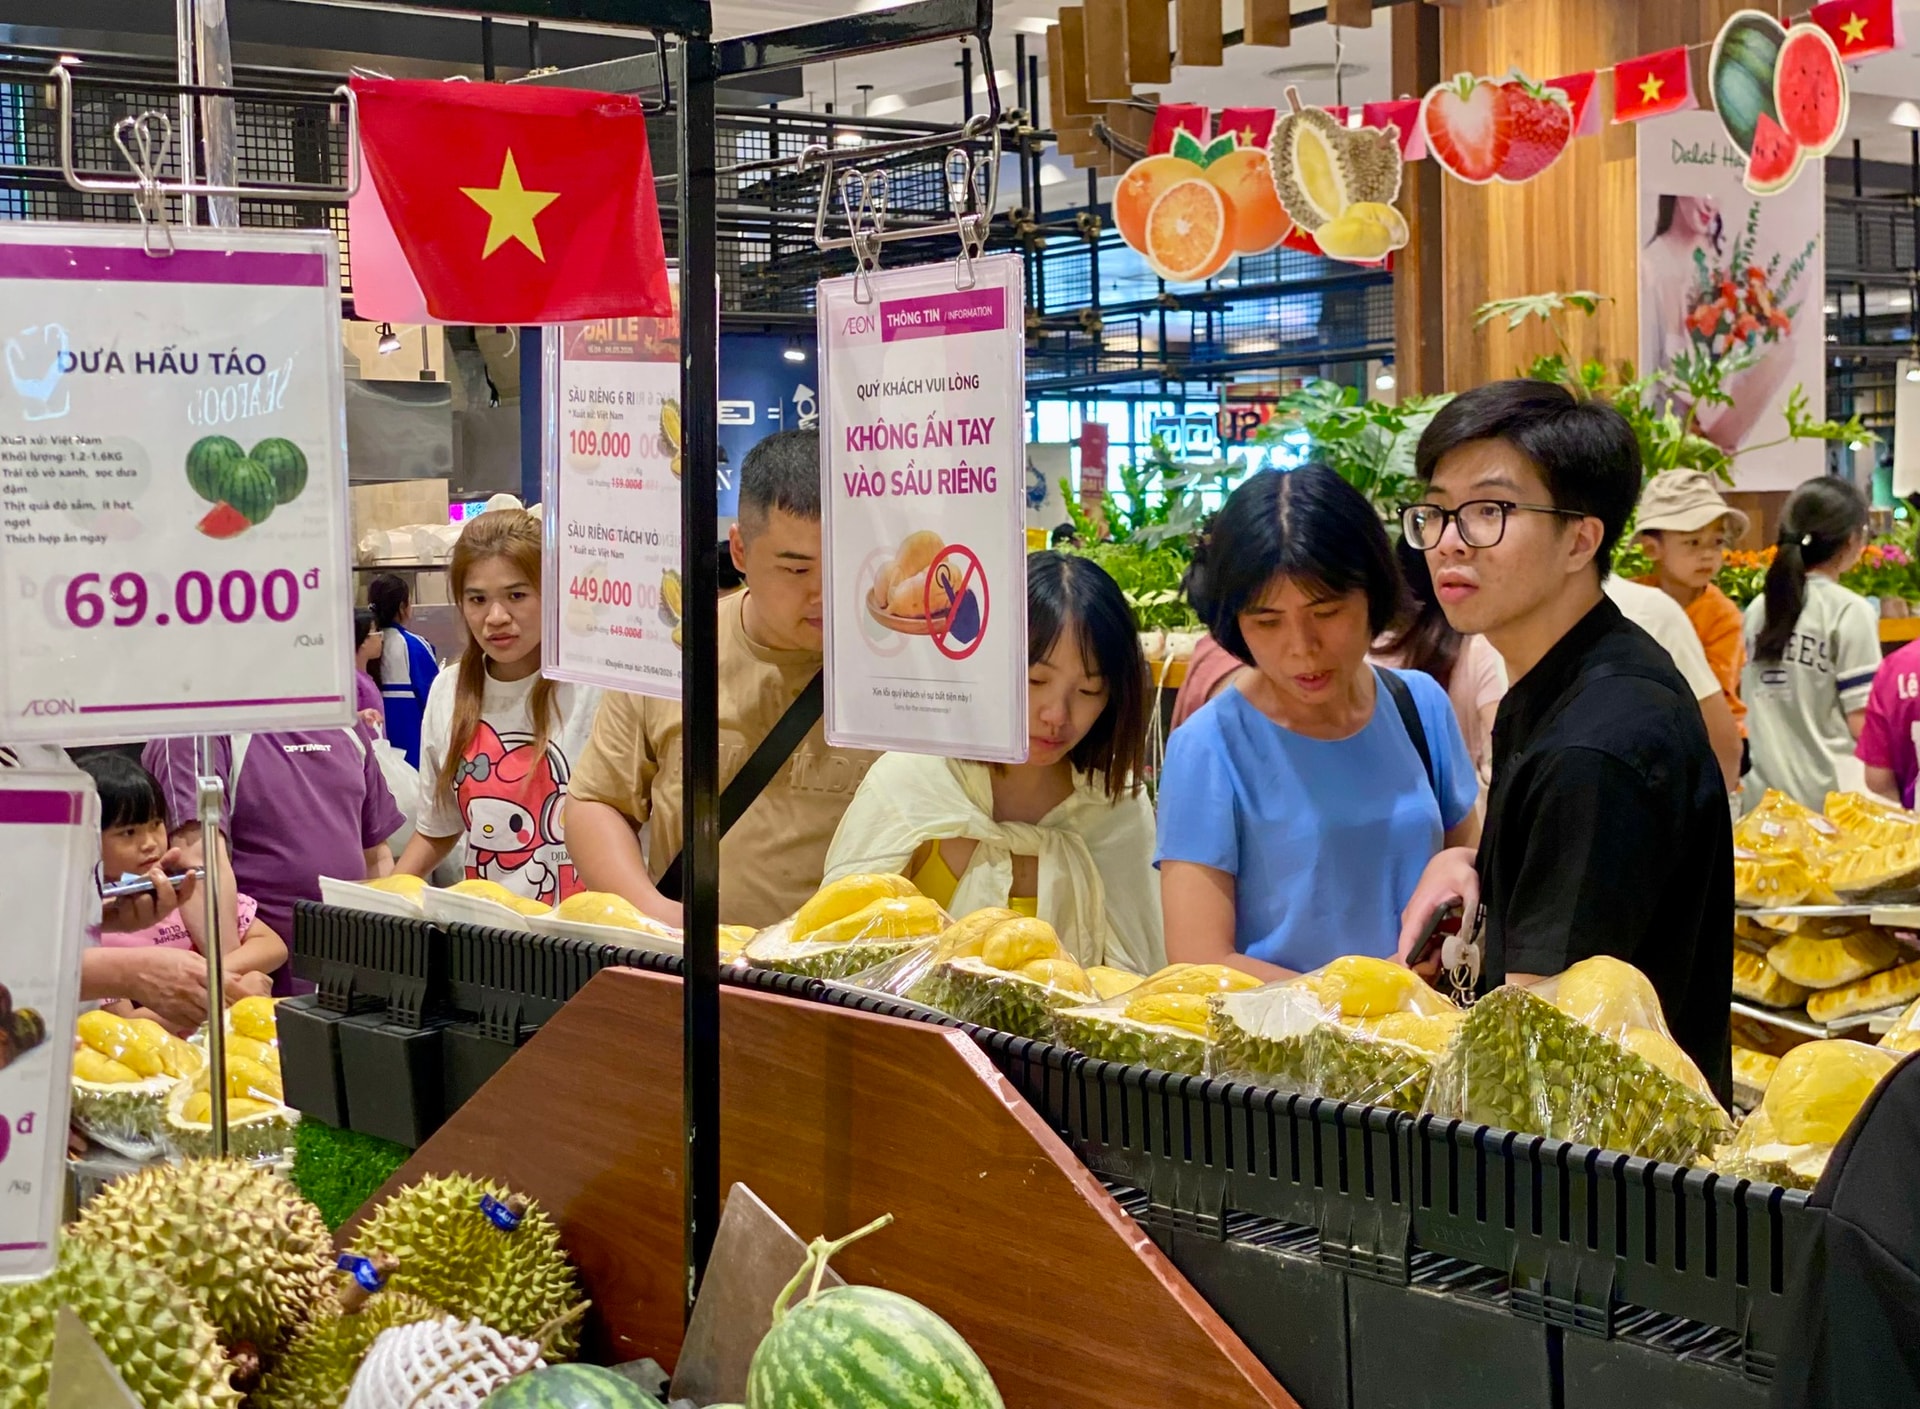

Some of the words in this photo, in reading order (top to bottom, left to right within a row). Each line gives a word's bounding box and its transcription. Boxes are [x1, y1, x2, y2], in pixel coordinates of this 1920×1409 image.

[1671, 138, 1717, 165] Dalat
[886, 309, 922, 328] THÔNG
[922, 307, 941, 323] TIN
[57, 348, 125, 375] DƯA
[135, 344, 199, 375] HẤU
[208, 346, 267, 376] TÁO
[856, 382, 880, 402] QUÝ
[882, 377, 923, 397] KHÁCH
[925, 379, 946, 393] VUI
[948, 371, 980, 391] LÒNG
[568, 385, 586, 402] SẦU
[588, 386, 616, 405] RIÊNG
[618, 391, 624, 405] 6
[626, 391, 635, 405] RI
[596, 409, 609, 421] Việt
[609, 412, 624, 421] Nam
[846, 417, 918, 453] KHÔNG
[922, 410, 953, 449] ẤN
[957, 416, 996, 446] TAY
[50, 436, 73, 447] Việt
[75, 436, 103, 446] Nam
[569, 429, 631, 459] 109.000
[1, 451, 27, 462] Khối
[30, 452, 67, 464] lượng:
[2, 468, 23, 478] Trái
[25, 467, 39, 478] có
[58, 468, 89, 479] xanh,
[843, 464, 886, 498] VÀO
[890, 459, 933, 497] SẦU
[937, 460, 997, 495] RIÊNG
[3, 484, 28, 496] đậm
[4, 501, 26, 512] Thịt
[29, 500, 51, 513] quả
[4, 518, 32, 530] ngọt
[5, 533, 37, 544] Thích
[38, 533, 61, 545] hợp
[63, 532, 78, 543] ăn
[80, 534, 108, 546] ngay
[567, 520, 585, 538] SẦU
[588, 523, 616, 542] RIÊNG
[617, 527, 643, 545] TÁCH
[645, 529, 659, 546] VỎ
[573, 544, 587, 555] Xuất
[598, 546, 610, 559] Việt
[611, 549, 625, 560] Nam
[569, 575, 632, 608] 449.000
[293, 633, 325, 648] /Quả
[872, 687, 882, 697] Xin
[902, 688, 920, 699] khách
[158, 924, 181, 936] CLUB
